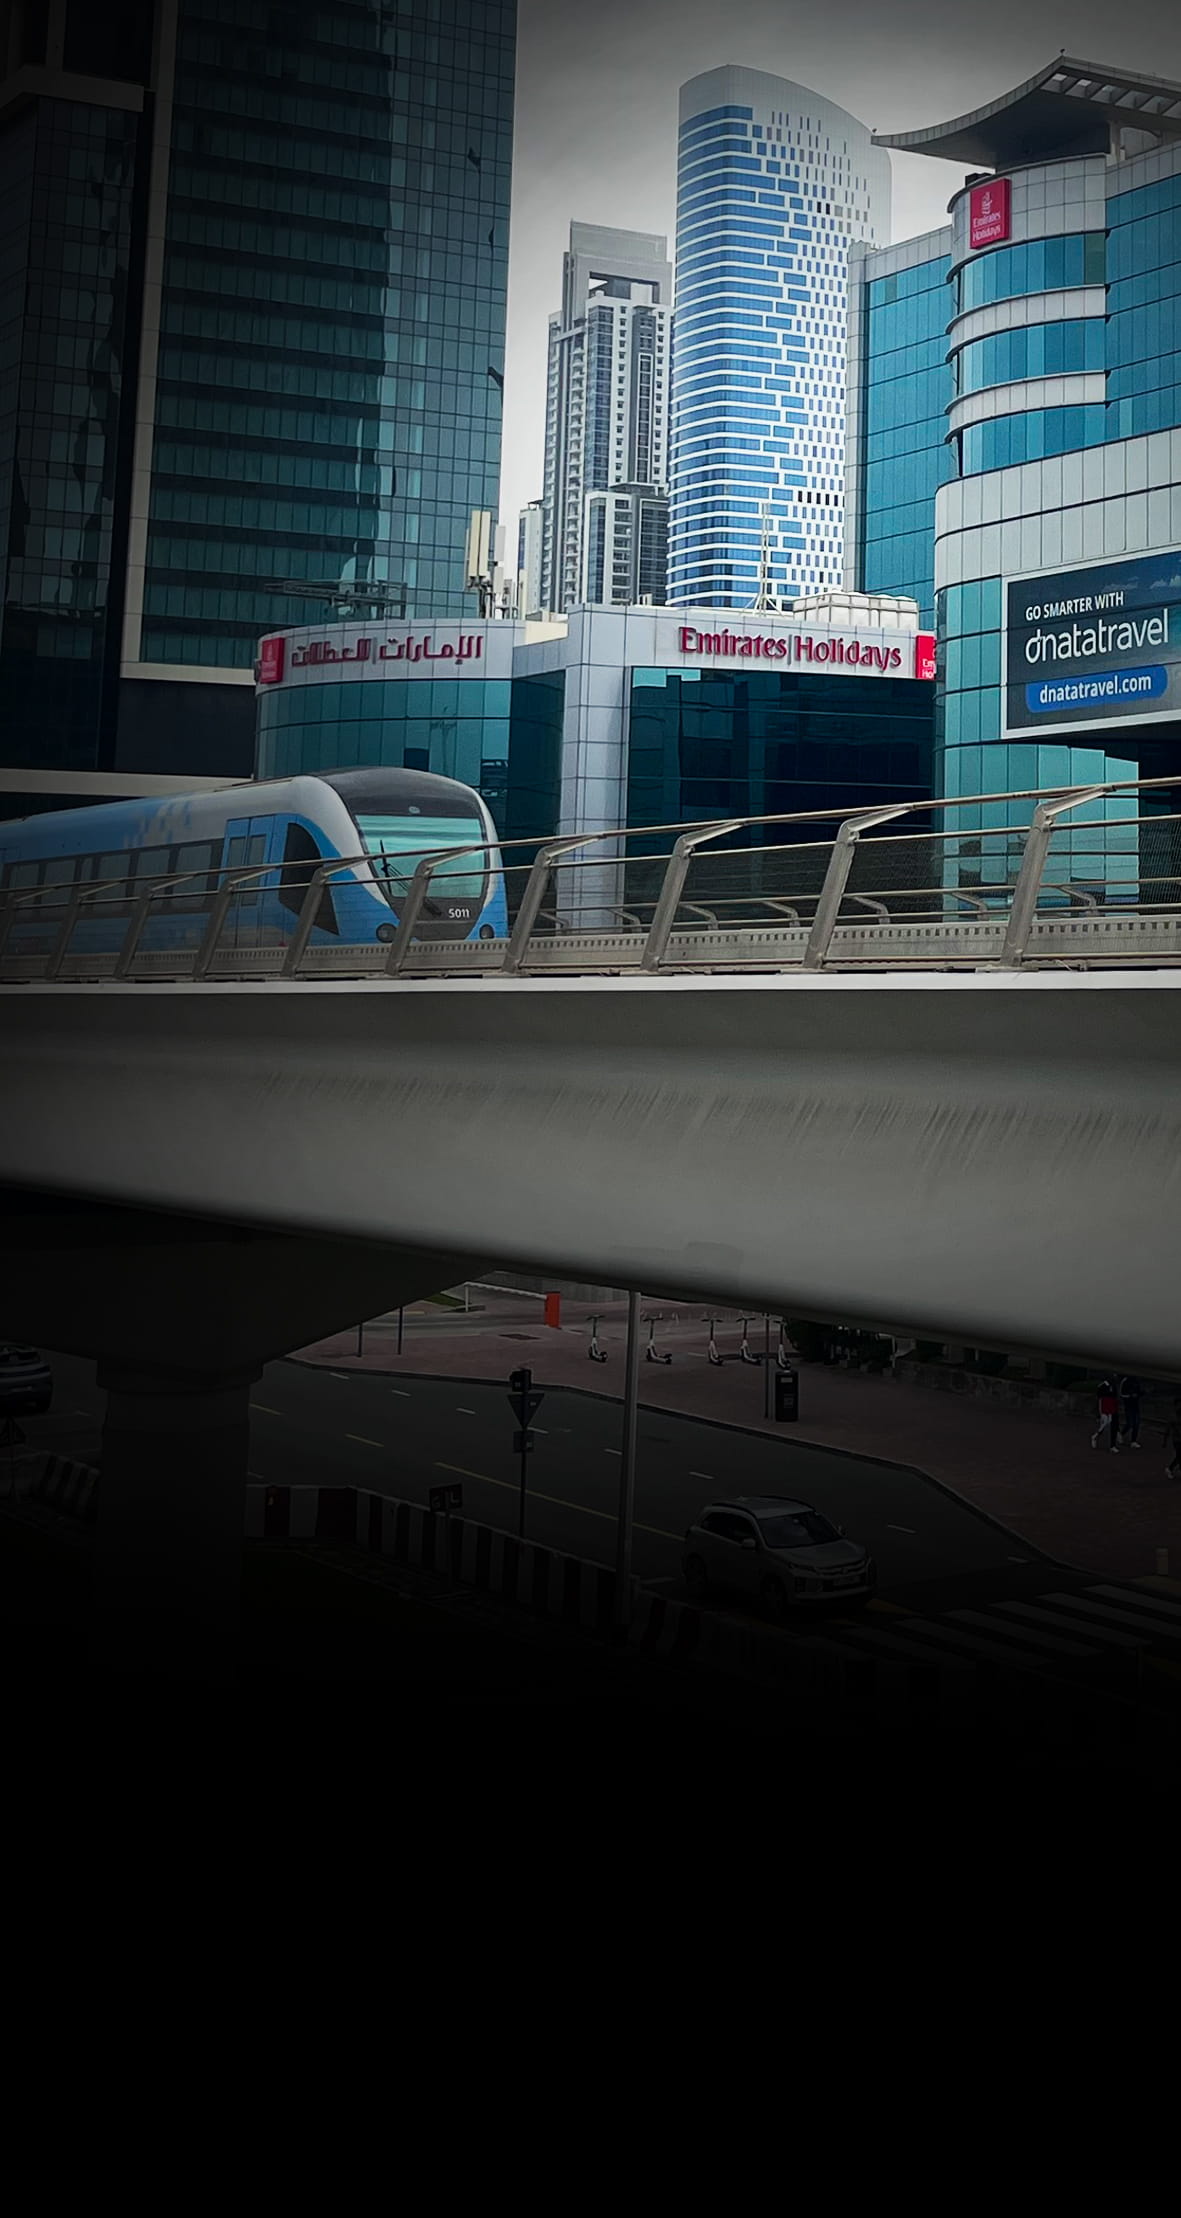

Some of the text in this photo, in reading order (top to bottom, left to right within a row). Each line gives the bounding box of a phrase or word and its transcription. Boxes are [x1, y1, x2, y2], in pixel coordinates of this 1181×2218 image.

[1025, 591, 1124, 621] GO SMARTER WITH
[679, 626, 902, 672] Emirates Holidays
[1025, 608, 1169, 664] dnatatravel
[1040, 675, 1152, 704] dnatatravel.com
[448, 908, 470, 919] 5011
